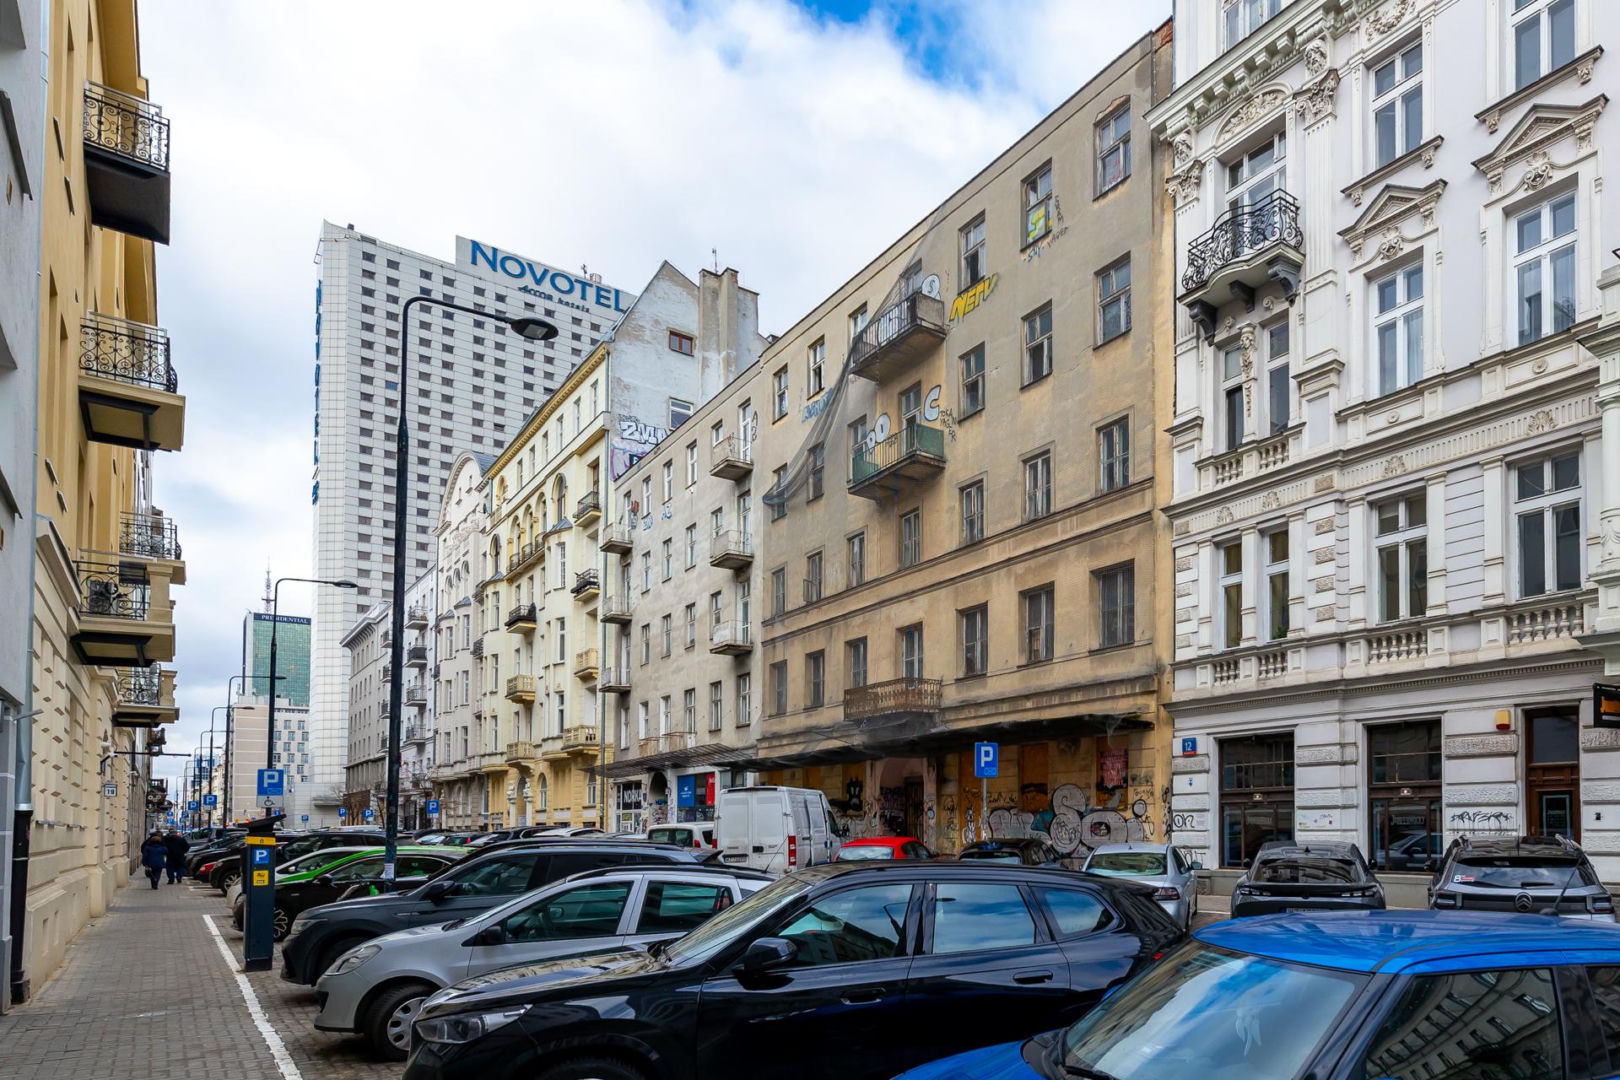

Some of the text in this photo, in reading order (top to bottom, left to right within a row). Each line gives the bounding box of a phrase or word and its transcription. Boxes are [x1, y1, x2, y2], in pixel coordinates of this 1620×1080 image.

[471, 239, 631, 314] NOVOTEL
[261, 614, 308, 624] PREIDENTIAL
[1185, 742, 1192, 751] 12
[981, 746, 994, 768] P
[263, 771, 279, 788] P
[206, 796, 215, 804] P
[429, 802, 437, 810] P
[255, 849, 267, 861] P
